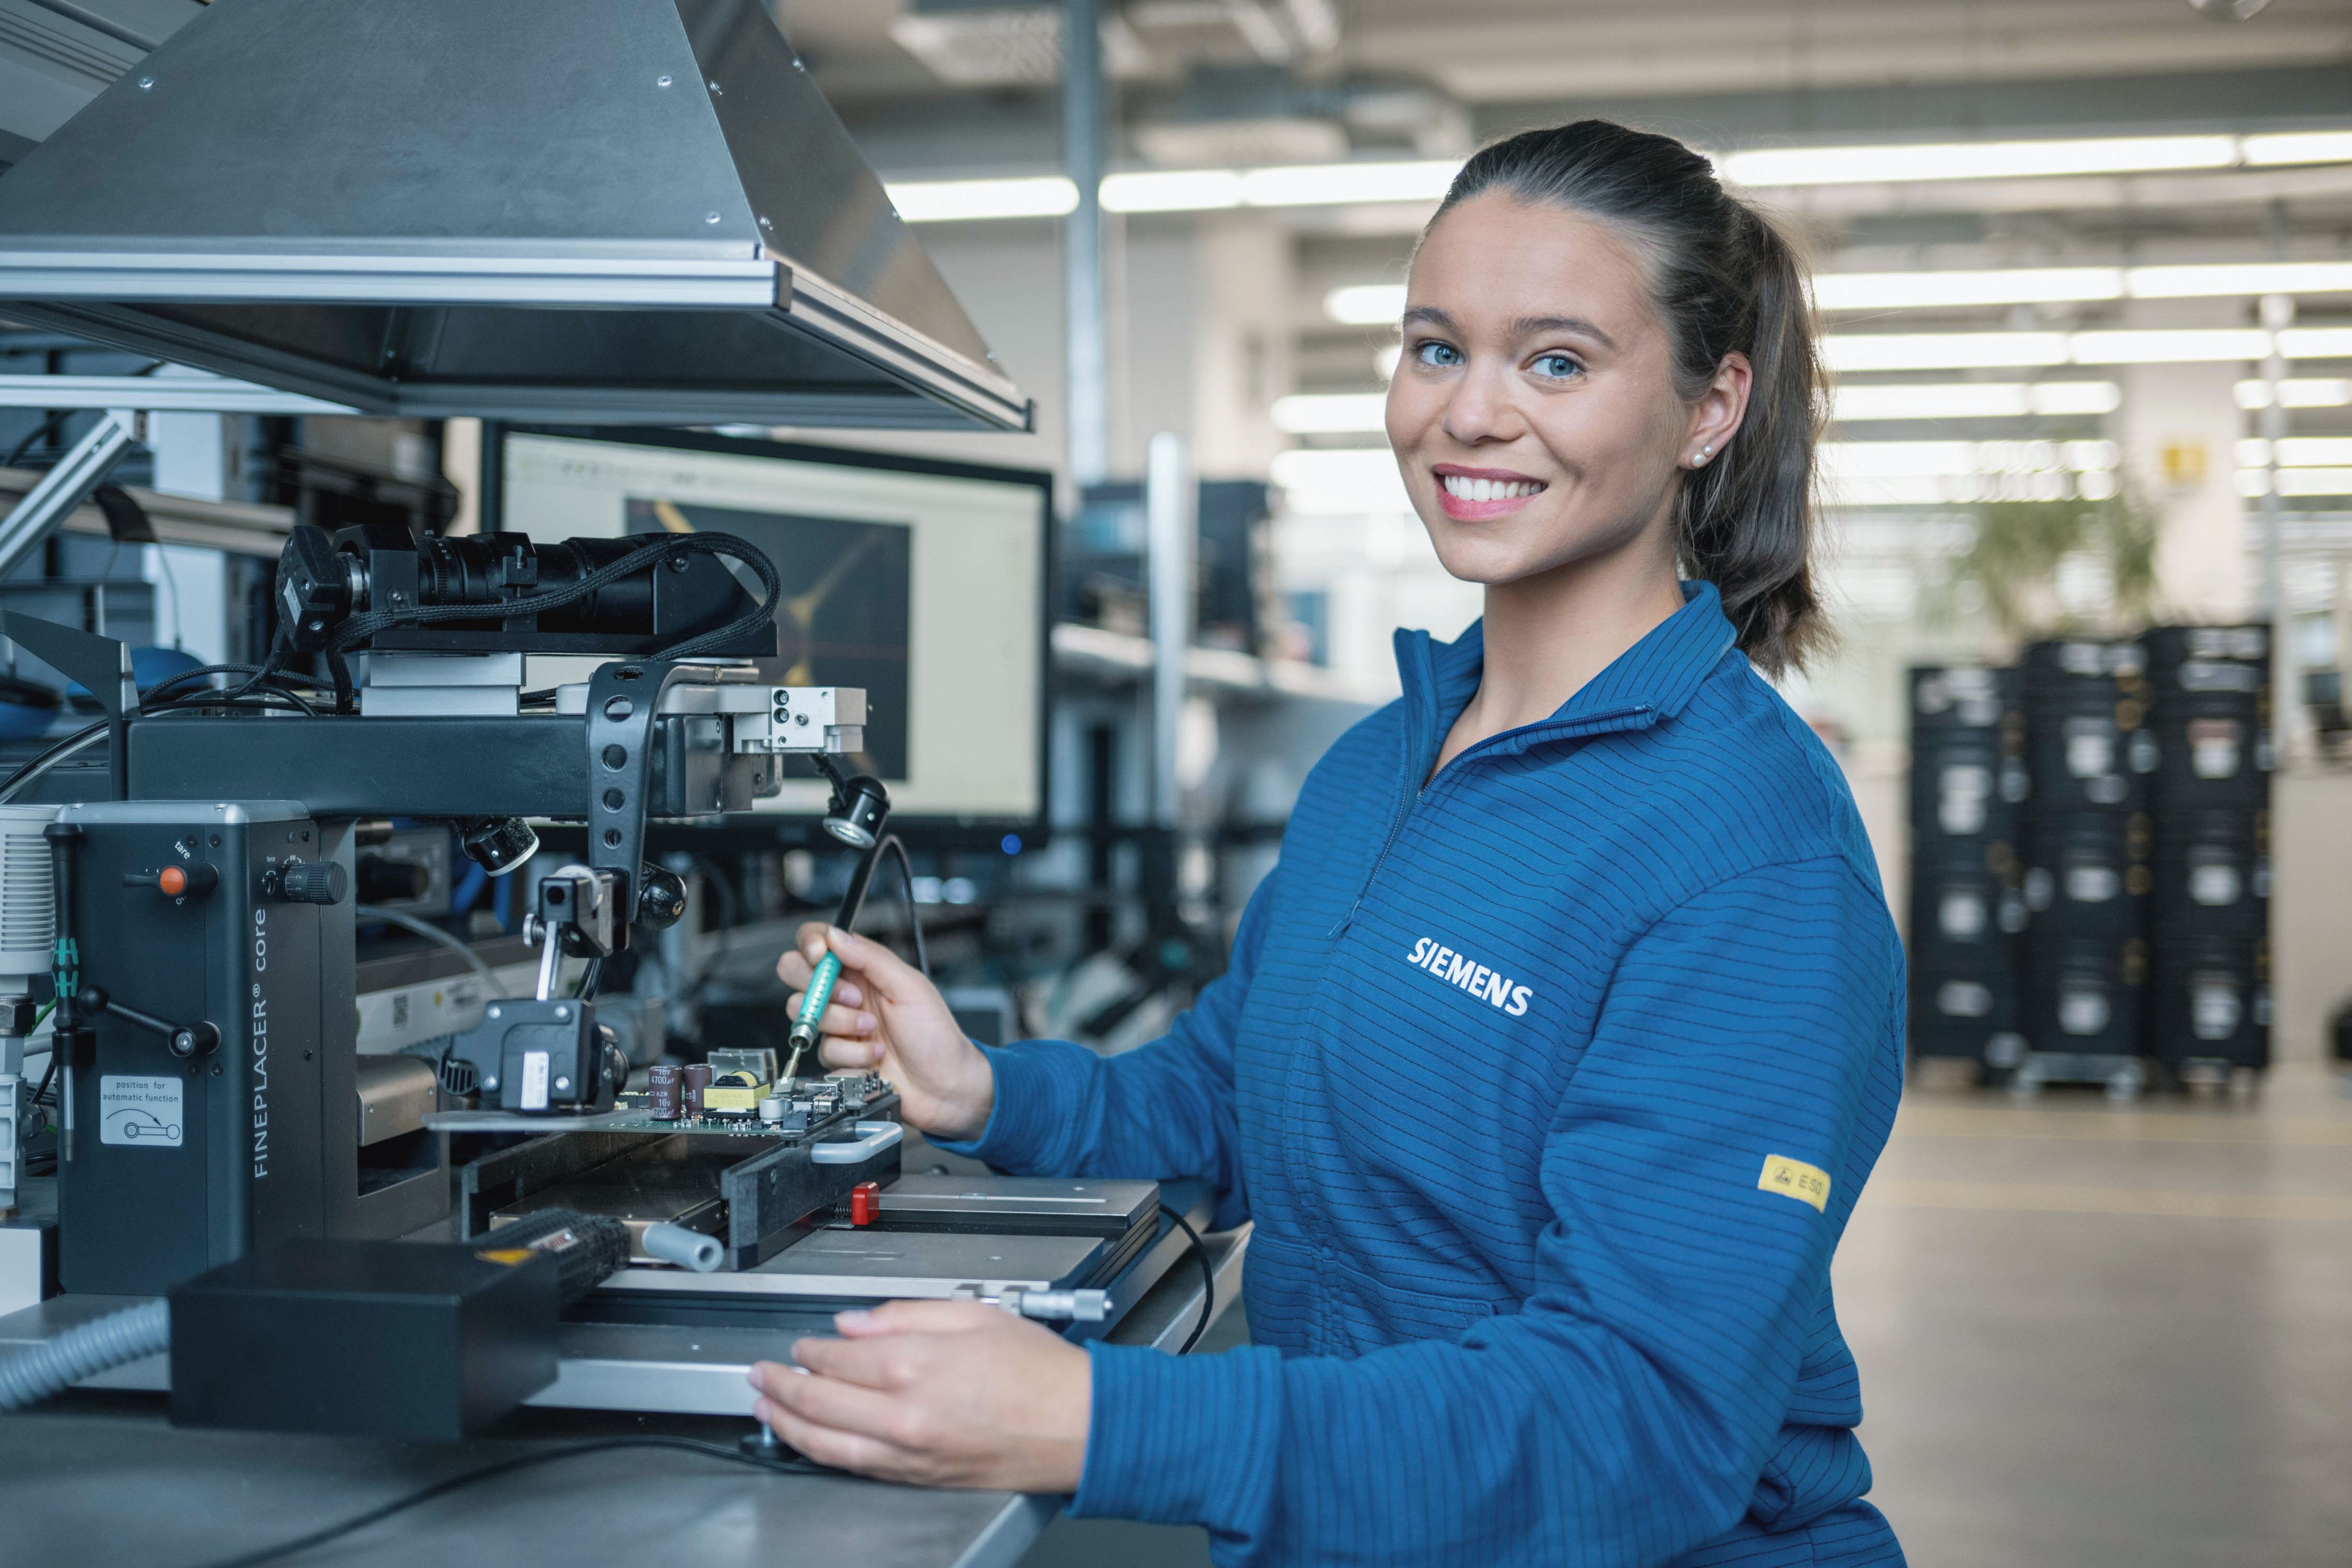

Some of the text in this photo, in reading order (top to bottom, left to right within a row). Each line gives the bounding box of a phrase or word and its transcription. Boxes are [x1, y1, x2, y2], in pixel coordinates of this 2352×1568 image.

[174, 841, 191, 860] tare
[255, 909, 266, 972] core
[1406, 937, 1533, 1016] SIEMENS
[116, 1081, 166, 1089] position for
[145, 1094, 179, 1102] function
[1798, 1174, 1822, 1195] ESD
